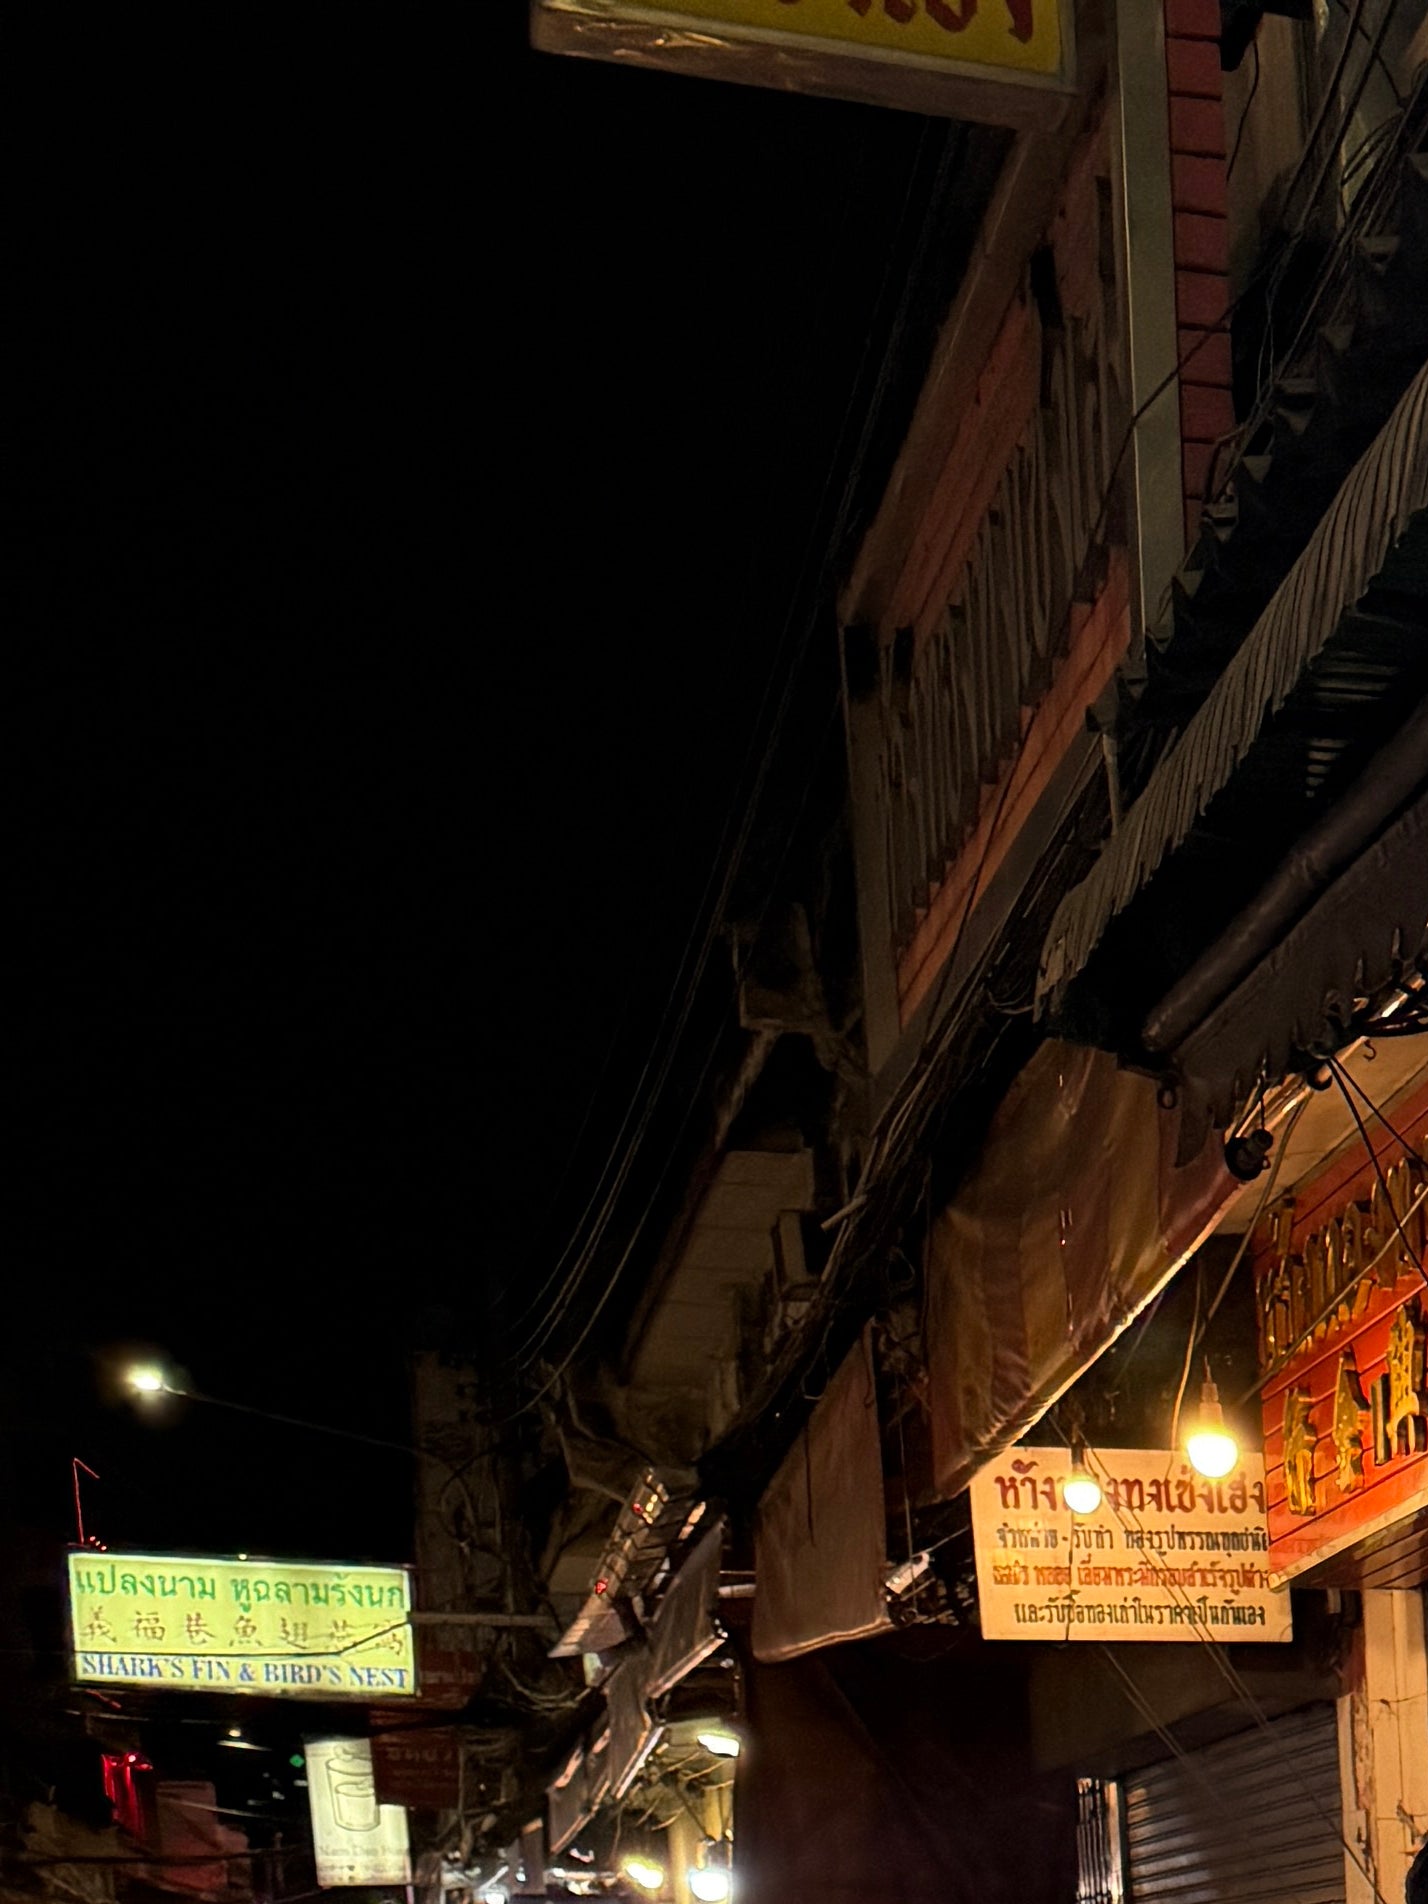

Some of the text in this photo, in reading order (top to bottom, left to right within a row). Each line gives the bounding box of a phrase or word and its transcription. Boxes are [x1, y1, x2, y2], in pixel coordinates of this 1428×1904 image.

[75, 1564, 216, 1601] แปลงนาม
[82, 1655, 408, 1689] SHARK'S FIN & BIRD'S NEST
